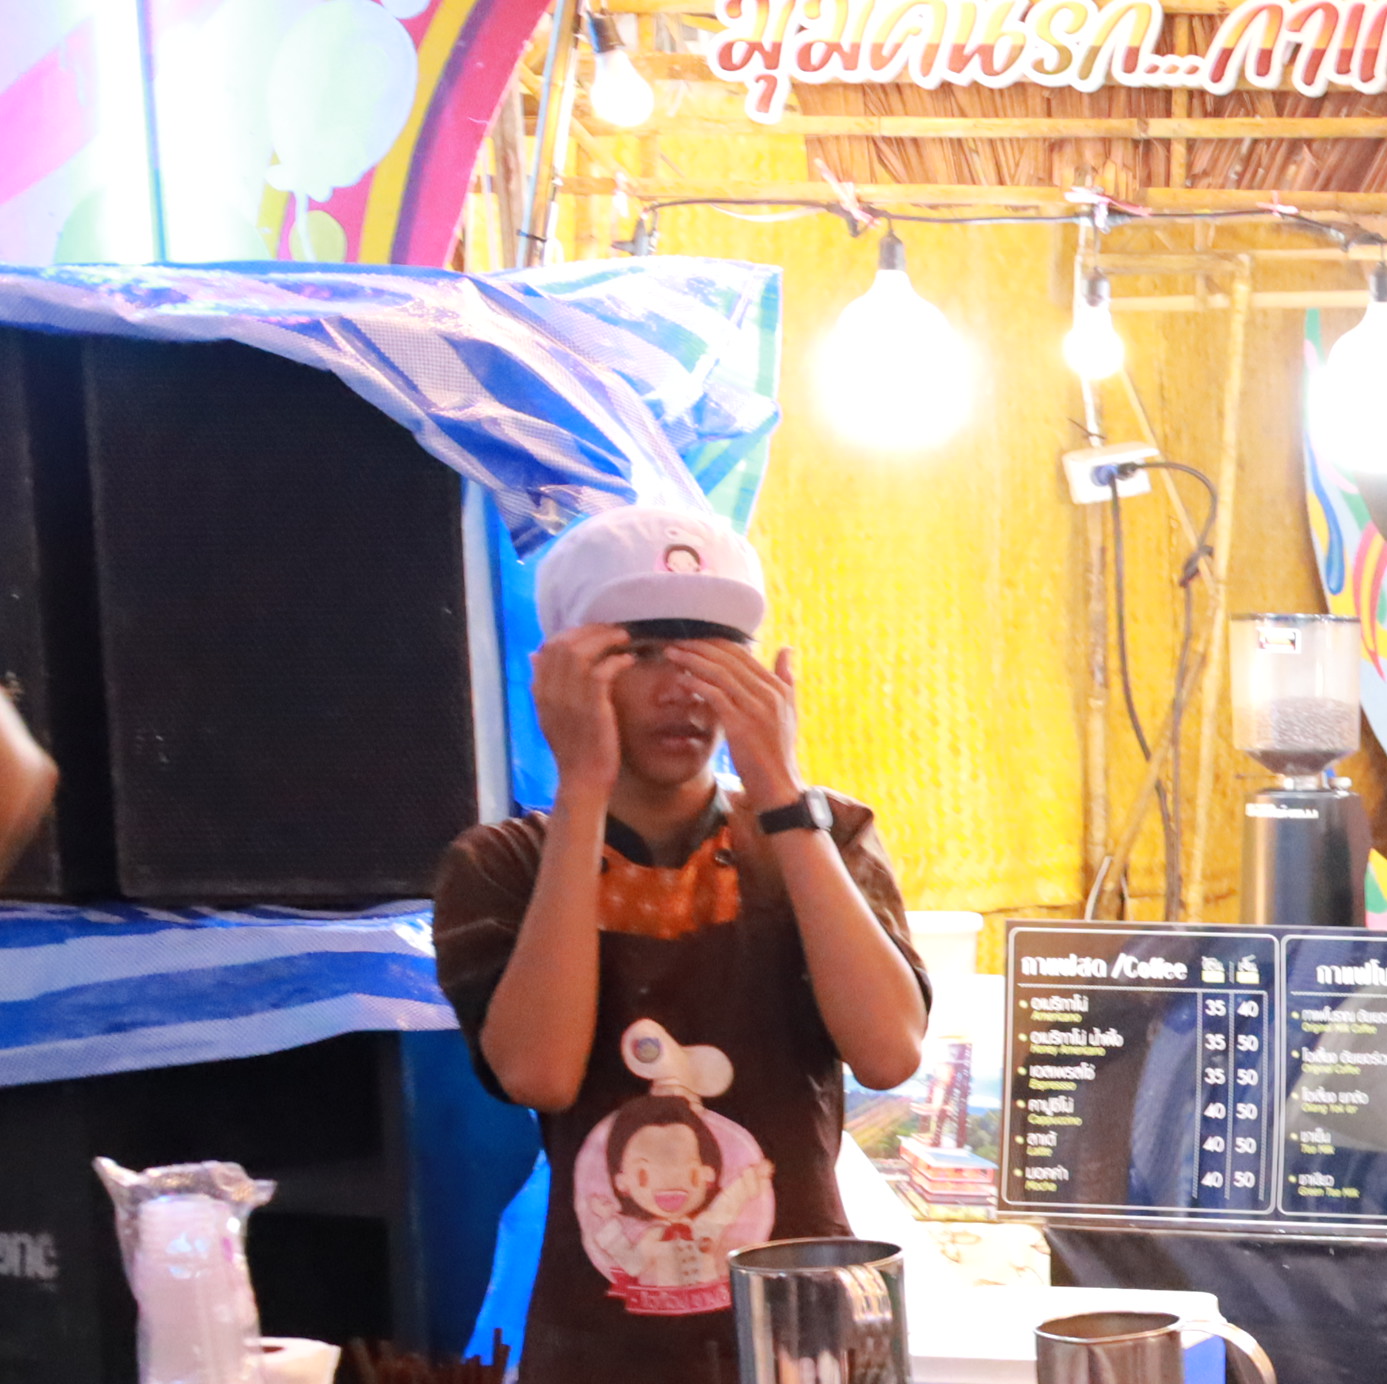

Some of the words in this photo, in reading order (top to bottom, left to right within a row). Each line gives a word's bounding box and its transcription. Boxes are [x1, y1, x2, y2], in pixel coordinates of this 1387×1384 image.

[1021, 953, 1107, 978] กาแฟสด
[1205, 998, 1226, 1017] 35
[1237, 1000, 1260, 1018] 40
[1205, 1033, 1226, 1051] 35
[1237, 1034, 1259, 1052] 50
[1204, 1067, 1226, 1085] 35
[1237, 1068, 1259, 1086] 50
[1203, 1102, 1226, 1120] 40
[1236, 1102, 1258, 1121] 50
[1202, 1136, 1225, 1154] 40
[1235, 1136, 1257, 1155] 50
[1201, 1171, 1224, 1189] 40
[1233, 1171, 1256, 1189] 50
